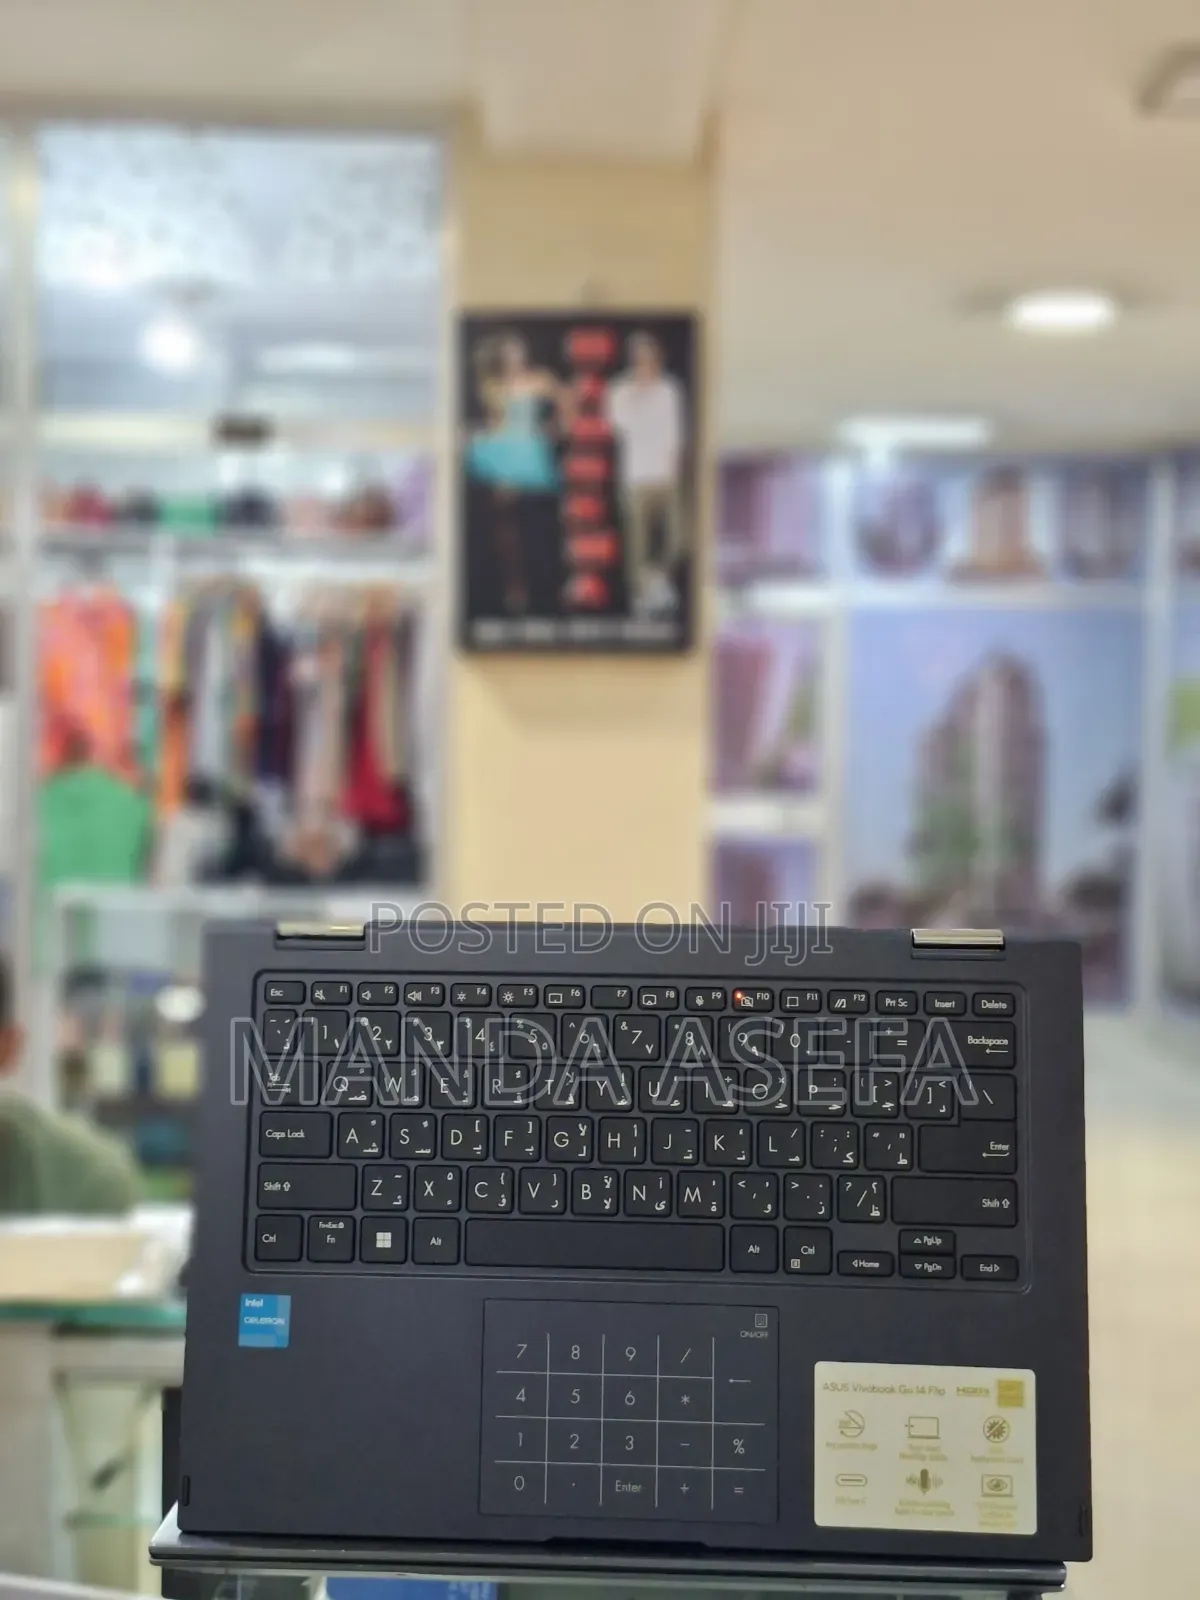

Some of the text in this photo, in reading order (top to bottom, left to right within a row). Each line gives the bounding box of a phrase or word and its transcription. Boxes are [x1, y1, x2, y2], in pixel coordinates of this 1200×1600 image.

[270, 988, 283, 997] Esc
[384, 986, 393, 994] F2
[523, 988, 533, 996] F5
[571, 989, 580, 997] F6
[617, 990, 627, 998] F7
[665, 991, 675, 999] F8
[711, 991, 721, 999] F9
[756, 992, 769, 1000] F10
[807, 993, 818, 1001] F11
[853, 994, 865, 1002] F12
[897, 998, 908, 1007] Sc
[935, 999, 955, 1008] Insert
[981, 1000, 1007, 1010] Delete
[323, 1025, 327, 1040] 1
[372, 1026, 382, 1041] 2
[424, 1027, 433, 1041] 3
[475, 1028, 486, 1042] 4
[528, 1029, 538, 1043] 5
[579, 1030, 590, 1044] 6
[631, 1030, 643, 1045] 7
[685, 1031, 694, 1046] 8
[737, 1032, 748, 1046] 9
[790, 1033, 801, 1048] 0
[967, 1036, 1008, 1046] Backspace
[332, 1076, 349, 1092] Q
[384, 1077, 402, 1093] W
[440, 1078, 449, 1094] E
[492, 1079, 502, 1094] R
[545, 1080, 555, 1095] T
[596, 1080, 607, 1096] Y
[648, 1081, 660, 1097] U
[752, 1083, 769, 1100] O
[809, 1085, 818, 1100] P
[265, 1129, 305, 1139] Caps Lock
[346, 1128, 359, 1144] A
[399, 1128, 410, 1145] S
[450, 1130, 463, 1145] D
[504, 1130, 514, 1146] F
[554, 1132, 569, 1147] G
[608, 1133, 621, 1148] H
[663, 1134, 672, 1150] J
[714, 1135, 725, 1150] K
[769, 1136, 777, 1152] L
[989, 1142, 1009, 1151] Enter
[264, 1182, 281, 1191] Shift
[371, 1180, 383, 1196] Z
[424, 1181, 434, 1197] X
[474, 1182, 488, 1198] C
[527, 1182, 540, 1198] V
[581, 1184, 592, 1200] B
[633, 1185, 646, 1201] N
[684, 1187, 702, 1203] M
[982, 1199, 999, 1208] Shift
[262, 1234, 276, 1243] Ctrl
[326, 1234, 336, 1243] Fn
[430, 1236, 442, 1246] Alt
[923, 1236, 942, 1246] PgUp
[748, 1245, 760, 1254] Alt
[801, 1246, 815, 1255] Ctrl
[859, 1260, 880, 1269] Home
[923, 1262, 942, 1273] PgDn
[979, 1264, 993, 1273] End
[740, 1330, 768, 1339] ON/OFF
[516, 1343, 528, 1359] 7
[571, 1344, 581, 1360] 8
[625, 1346, 636, 1361] 9
[515, 1387, 526, 1402] 4
[571, 1388, 581, 1404] 5
[822, 1382, 849, 1393] ASUS
[851, 1383, 896, 1395] Vivobook
[898, 1384, 914, 1395] Go
[624, 1390, 635, 1406] 6
[518, 1432, 523, 1447] 1
[569, 1433, 580, 1449] 2
[625, 1435, 634, 1451] 3
[733, 1438, 745, 1454] %
[513, 1475, 525, 1491] 0
[615, 1480, 642, 1493] Enter
